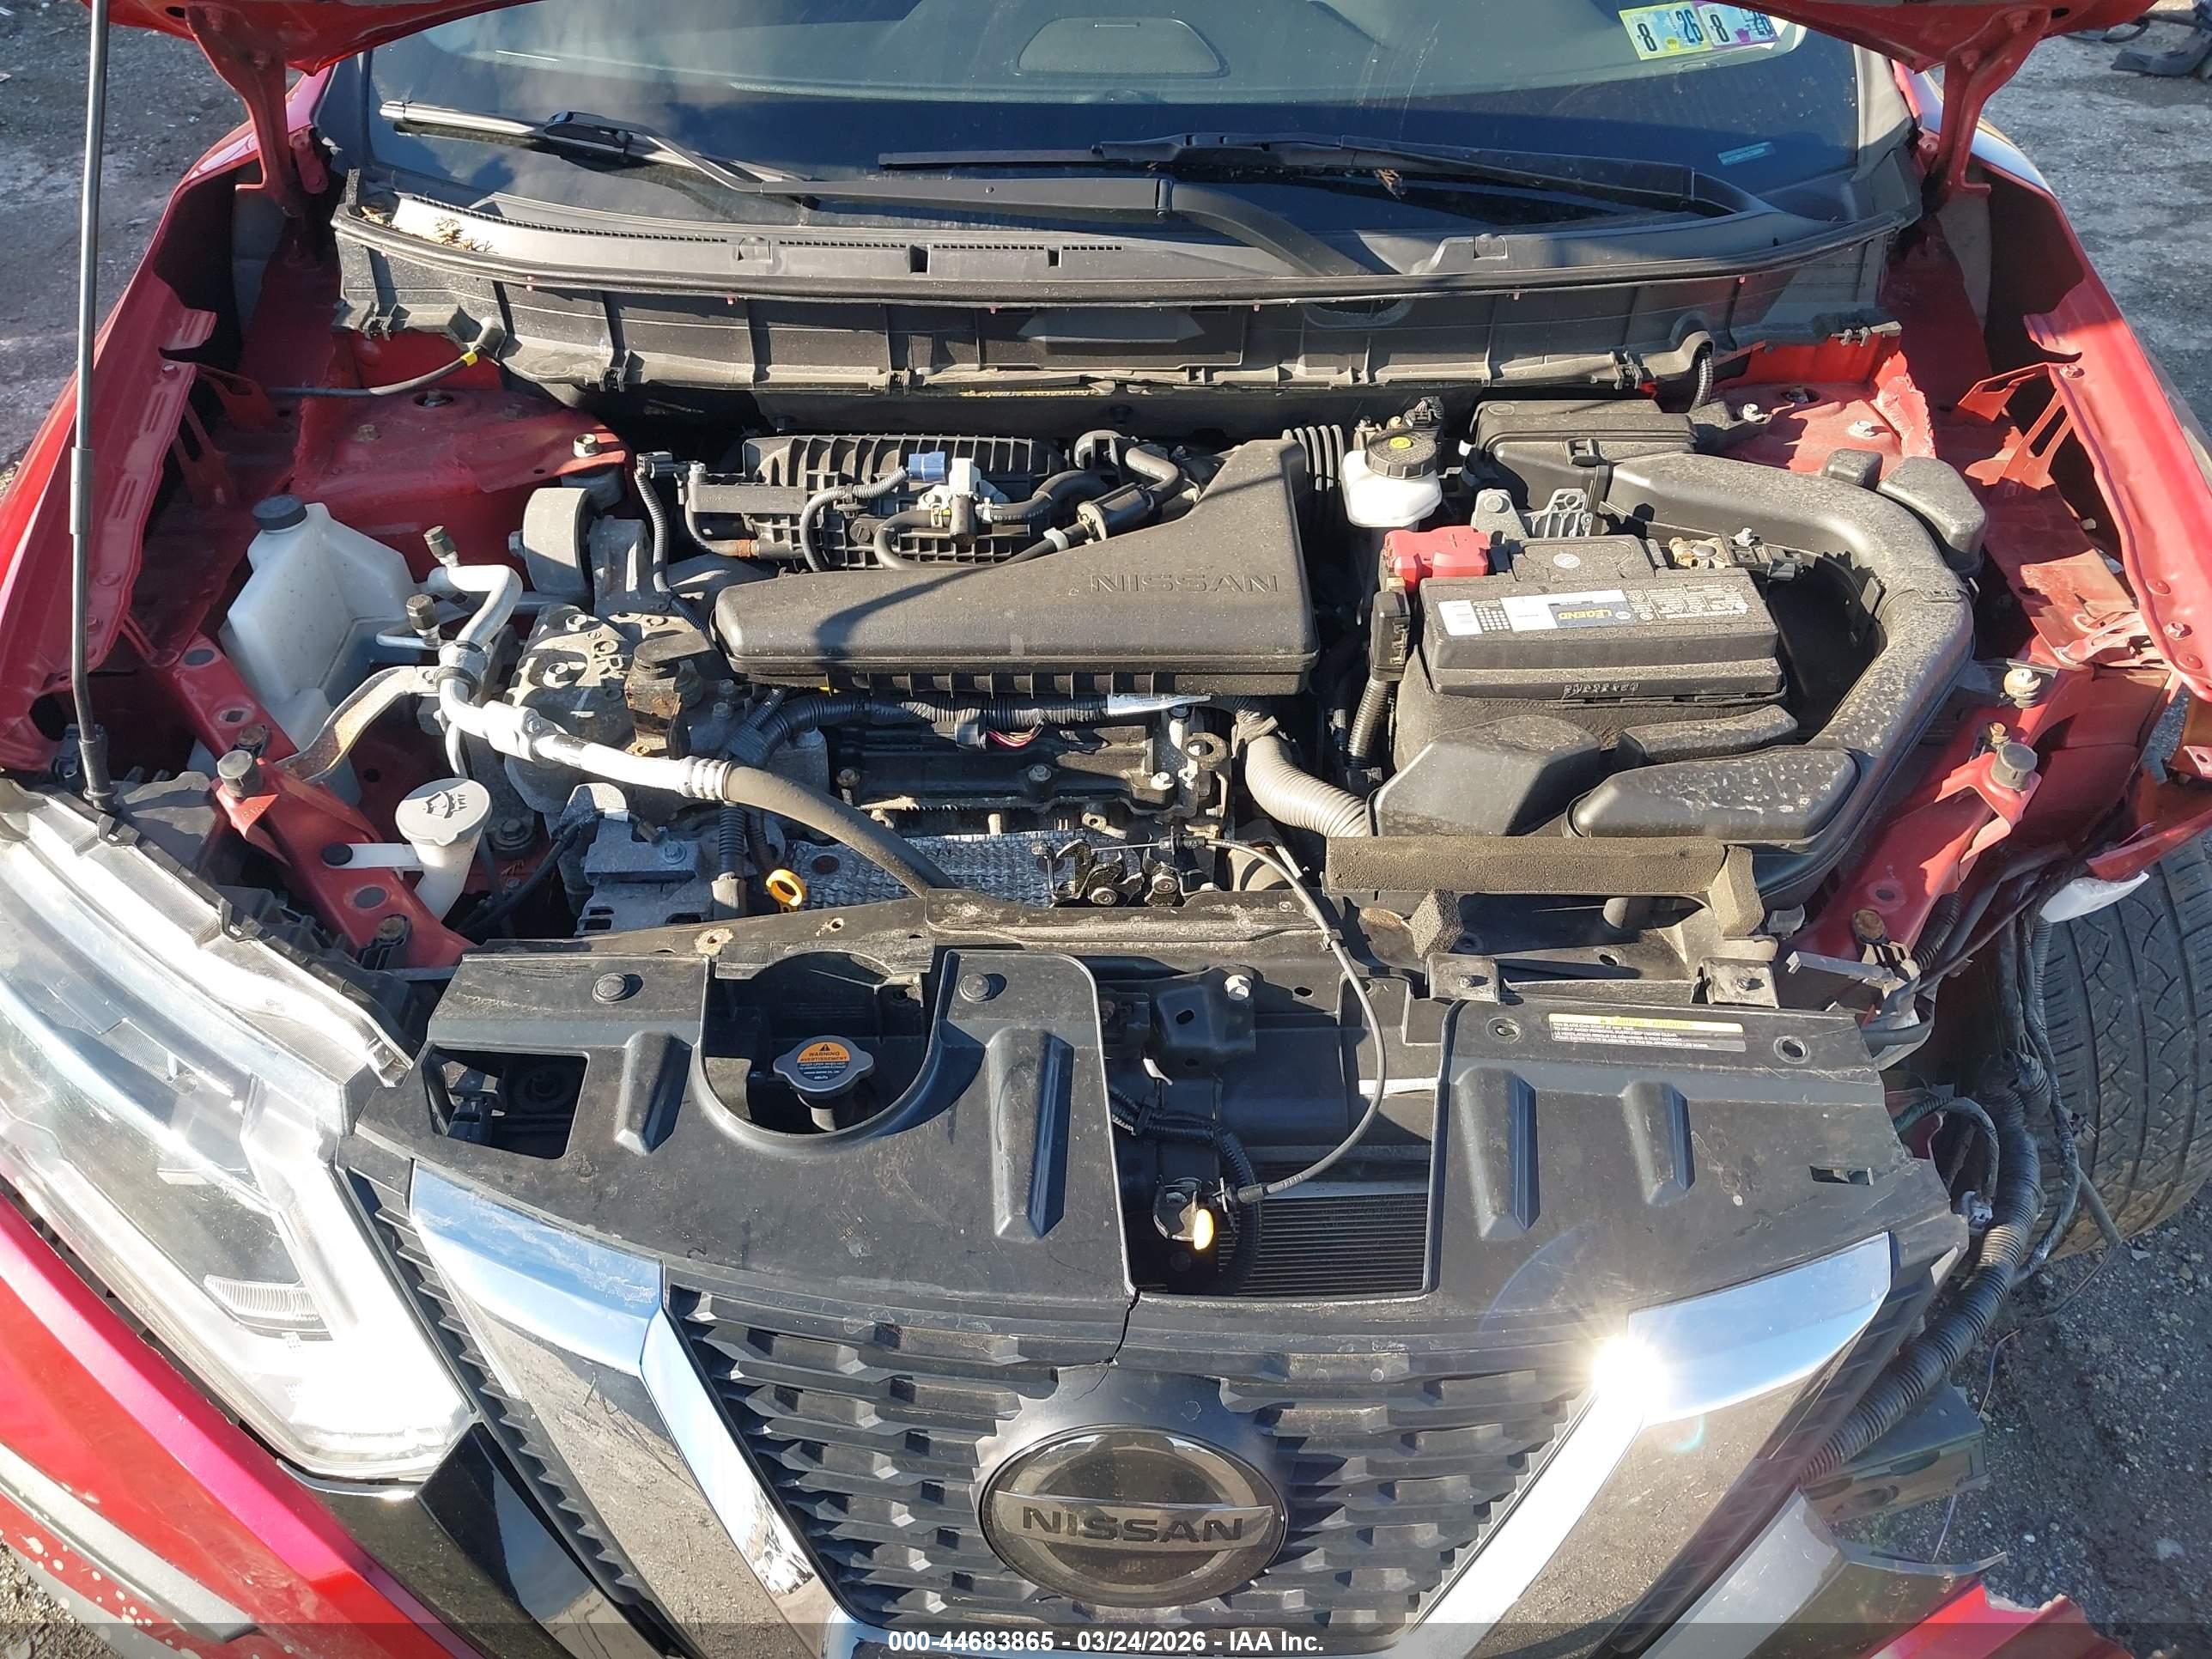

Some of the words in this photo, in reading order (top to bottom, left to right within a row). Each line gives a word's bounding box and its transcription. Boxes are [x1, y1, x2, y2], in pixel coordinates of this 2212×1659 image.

[1637, 23, 1658, 52] 8
[1674, 9, 1705, 43] 26
[1710, 14, 1730, 42] 8
[1090, 574, 1279, 592] NISSAN
[1557, 608, 1613, 620] LEGEND
[1022, 1505, 1243, 1544] NISSAN
